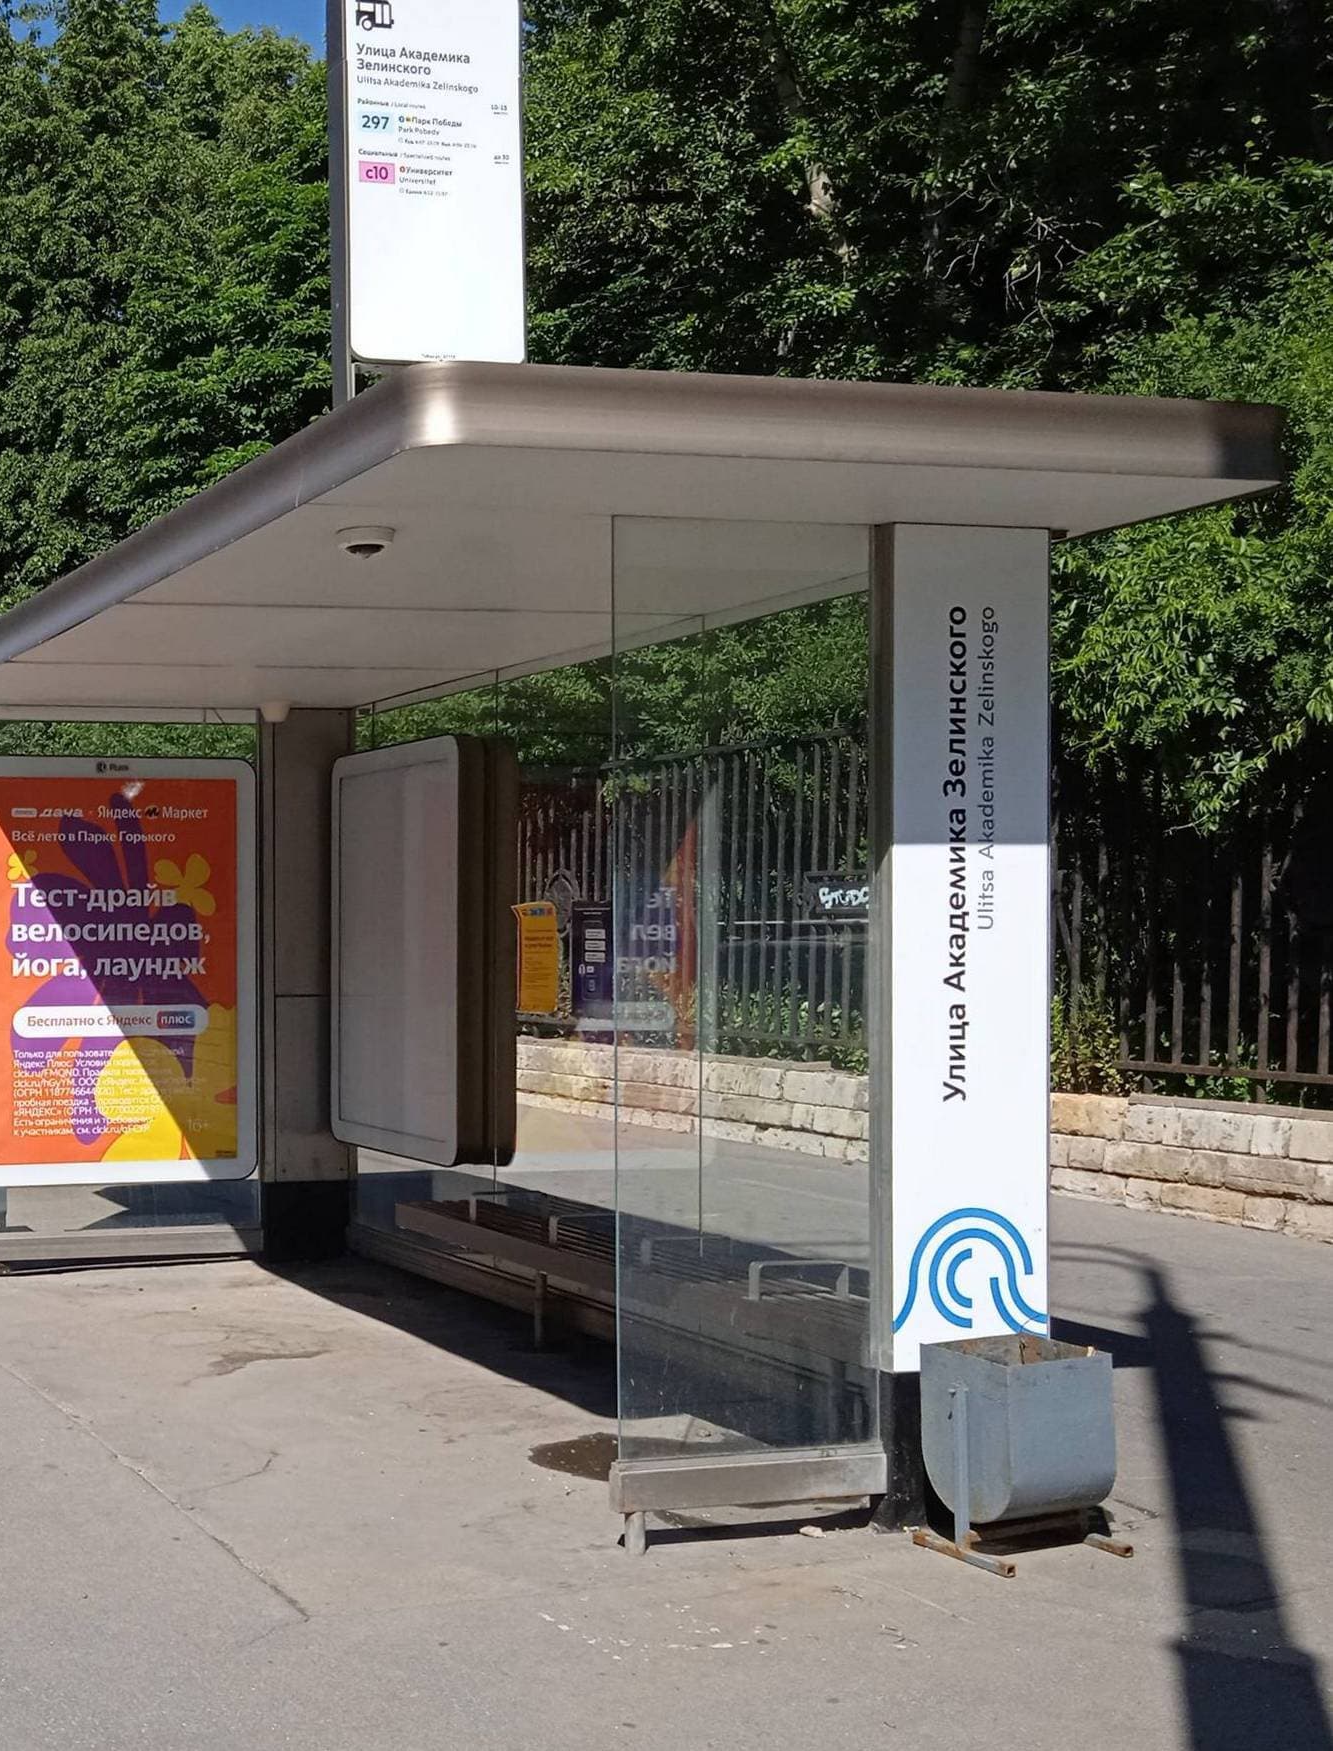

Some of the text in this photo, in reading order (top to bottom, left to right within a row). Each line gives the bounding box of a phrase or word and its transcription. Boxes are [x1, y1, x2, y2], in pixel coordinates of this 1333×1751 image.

[356, 43, 471, 64] Улица Академика
[356, 58, 431, 76] Зелинского
[356, 76, 479, 95] Ulitsa Akademika Zelinskogo
[361, 115, 390, 130] 297
[411, 116, 431, 127] Парк
[406, 167, 453, 177] Университет
[977, 605, 999, 931] Ulitsa Akademika Zelinskogo
[97, 806, 209, 820] Яндекс Маркет
[11, 830, 176, 845] Всё лето в Парке Горького
[942, 605, 969, 1103] Улица Академика Зелинского
[11, 882, 178, 913] Тест-драйв
[11, 922, 210, 946] велосипедов,
[11, 952, 206, 979] йога, лаундж
[27, 1015, 95, 1027] Бесплатно
[97, 1018, 104, 1026] с
[106, 1015, 152, 1027] Яндекс
[14, 1050, 44, 1058] Только
[46, 1051, 62, 1059] для
[14, 1060, 46, 1068] Яндекс
[75, 1059, 111, 1067] Условия
[14, 1098, 51, 1107] пробная
[14, 1118, 33, 1126] Есть
[34, 1118, 93, 1127] ограничения
